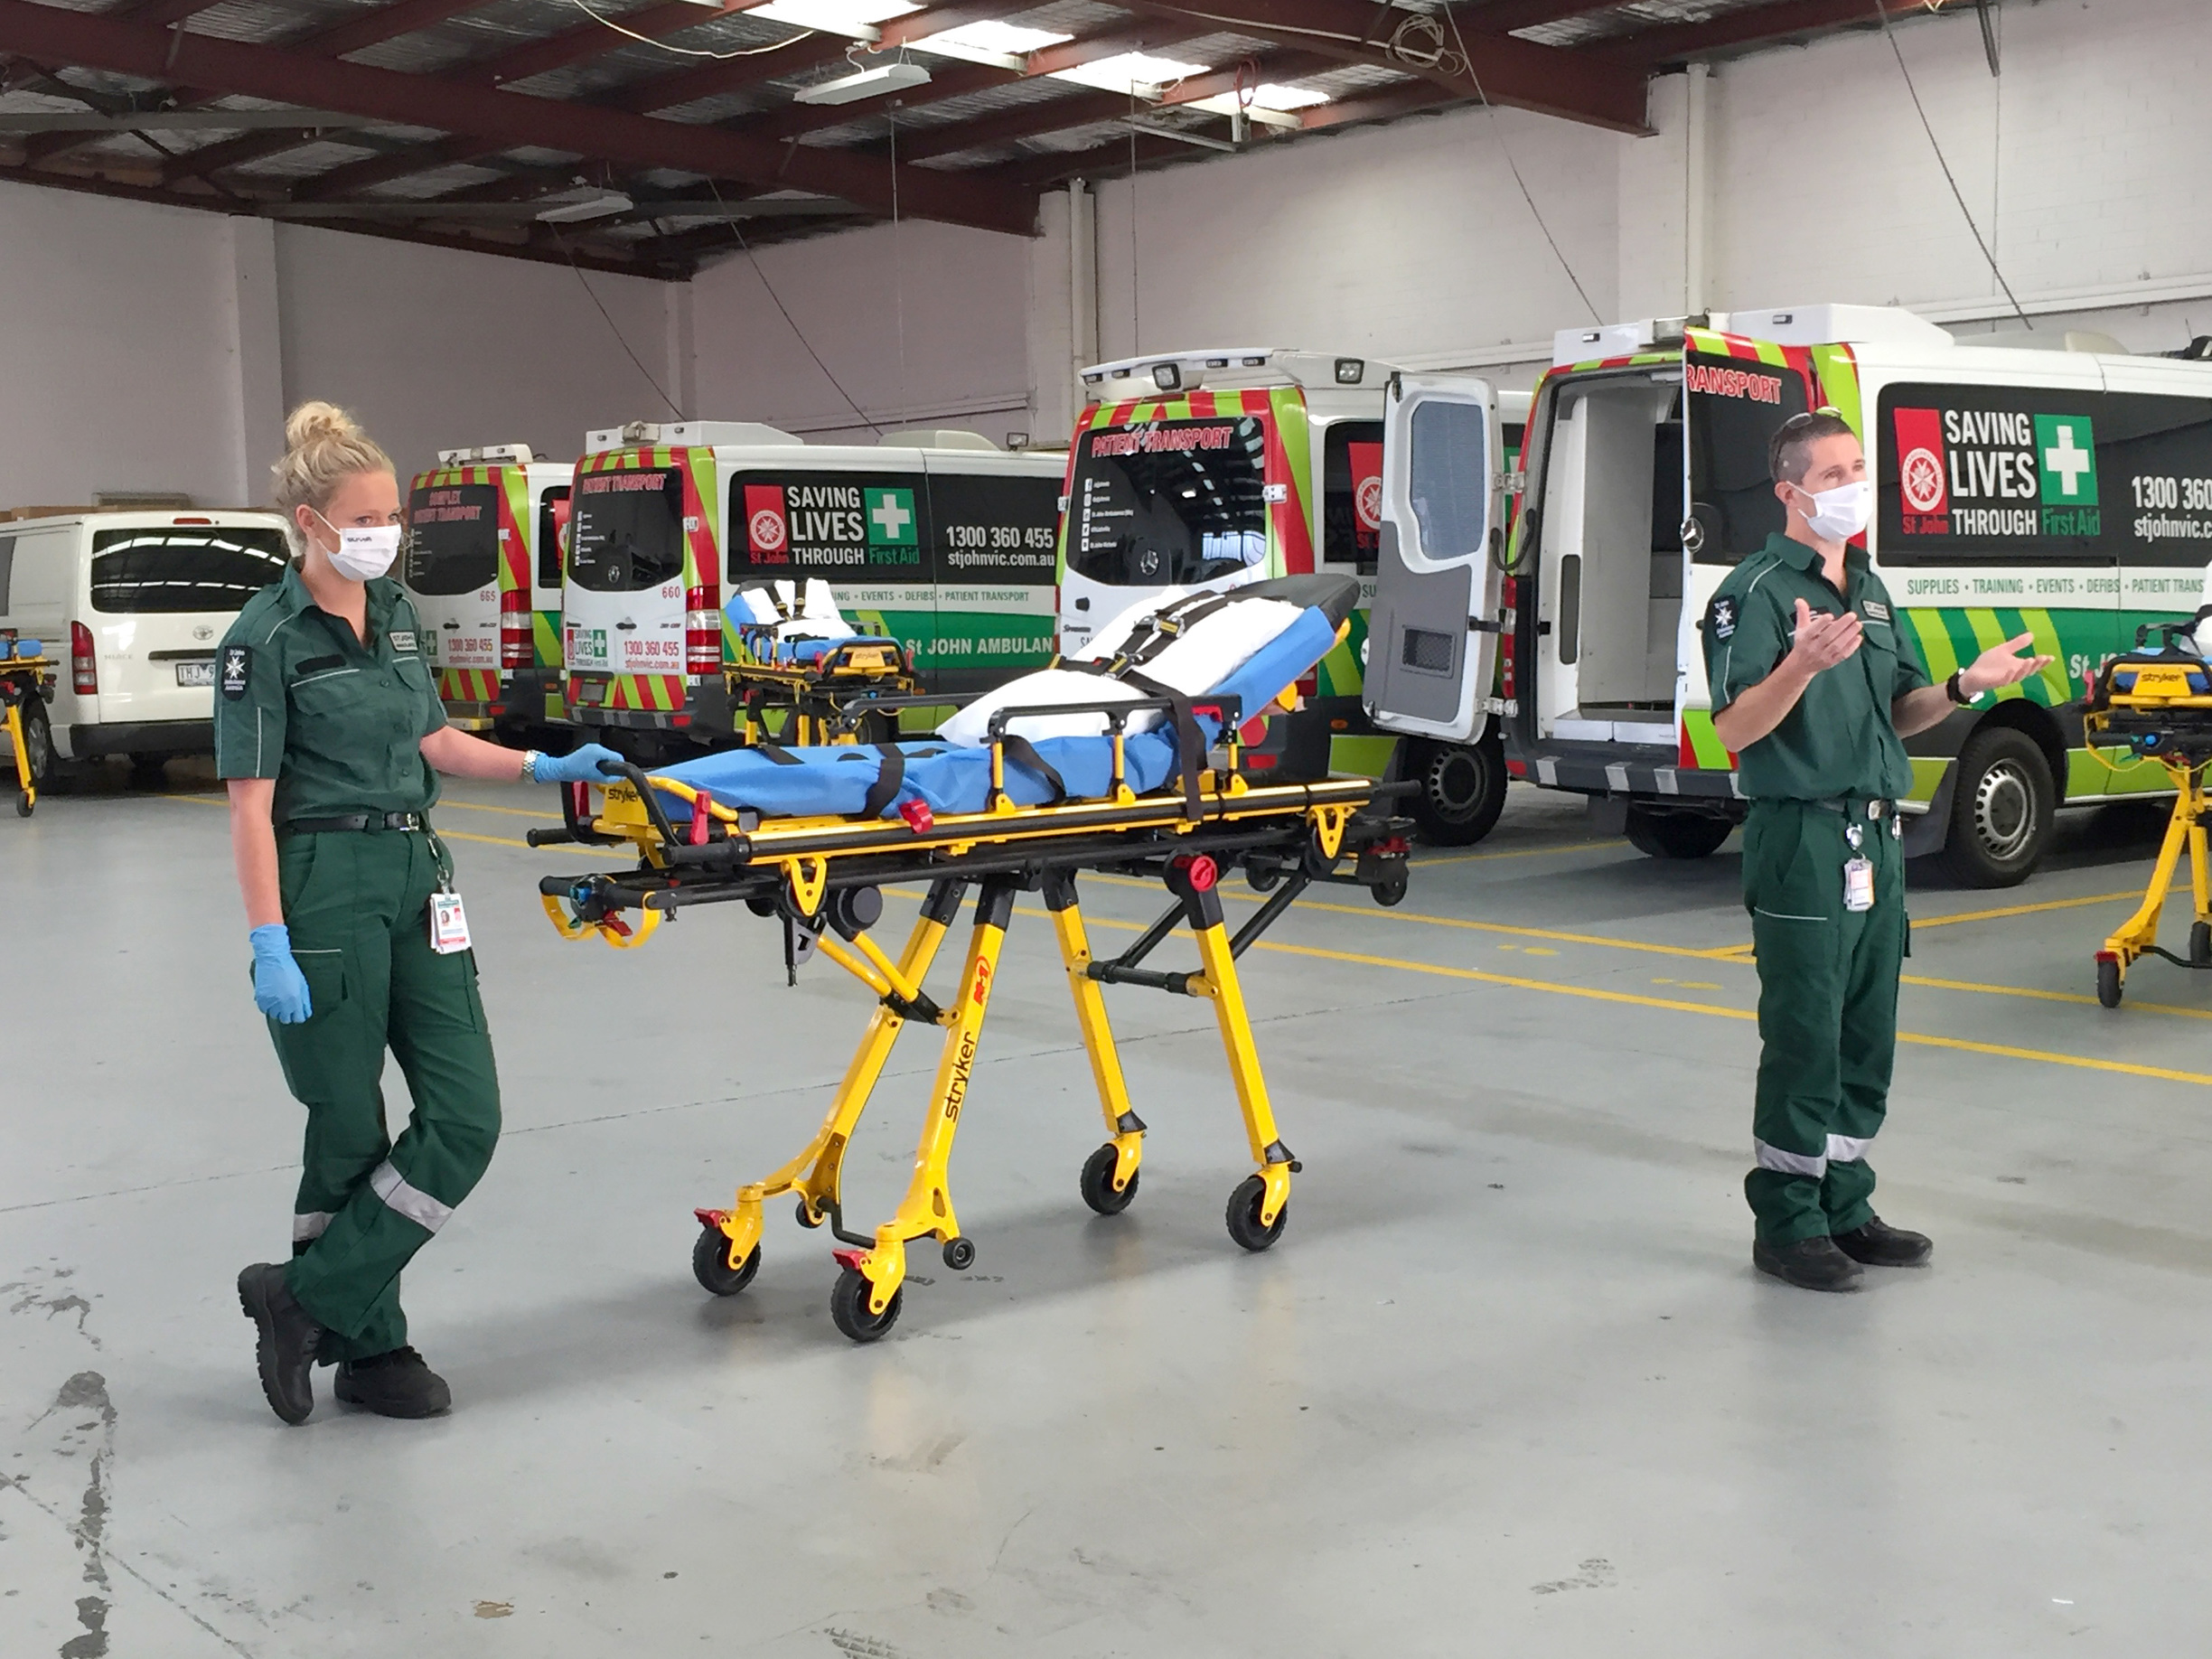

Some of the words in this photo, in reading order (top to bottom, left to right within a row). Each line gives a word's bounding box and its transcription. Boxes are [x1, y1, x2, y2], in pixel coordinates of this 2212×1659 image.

[1945, 409, 2031, 446] SAVING
[1092, 433, 1142, 458] PATIENT
[1144, 426, 1234, 453] TRANSPORT
[1950, 450, 2037, 499] LIVES
[787, 486, 860, 508] SAVING
[2132, 476, 2178, 510] 1300
[791, 511, 865, 541] LIVES
[1902, 516, 1917, 534] St
[1919, 516, 1949, 534] John
[1952, 508, 2038, 536] THROUGH
[2042, 508, 2076, 536] First
[2077, 509, 2101, 536] Aid
[946, 526, 987, 548] 1300
[989, 527, 1020, 548] 360
[1025, 528, 1054, 548] 455
[751, 552, 764, 564] St
[764, 551, 790, 564] John
[792, 548, 865, 565] THROUGH
[869, 547, 898, 565] First
[899, 547, 920, 565] Aid
[947, 549, 1055, 569] stjohnvic.com.au
[661, 586, 680, 598] 660
[1907, 578, 1960, 595] SUPPLIES
[1973, 578, 2023, 594] TRAINING
[2037, 578, 2075, 593] EVENTS
[2087, 578, 2120, 593] DEFIBS
[2132, 578, 2170, 593] PATIENT
[480, 590, 496, 602] 665
[861, 591, 895, 602] EVENTS
[905, 592, 934, 601] DEFIBS
[945, 592, 979, 601] PATIENT
[981, 592, 1029, 602] TRANSPORT
[464, 638, 477, 651] 360
[479, 638, 493, 651] 455
[575, 642, 593, 656] LIVES
[623, 641, 642, 655] 1300
[645, 641, 660, 656] 360
[662, 642, 680, 656] 455
[905, 639, 923, 655] St
[927, 638, 972, 654] JOHN
[625, 660, 680, 670] stjohnvic.com.au
[2142, 672, 2181, 683] stryker
[945, 1031, 976, 1123] stryker
